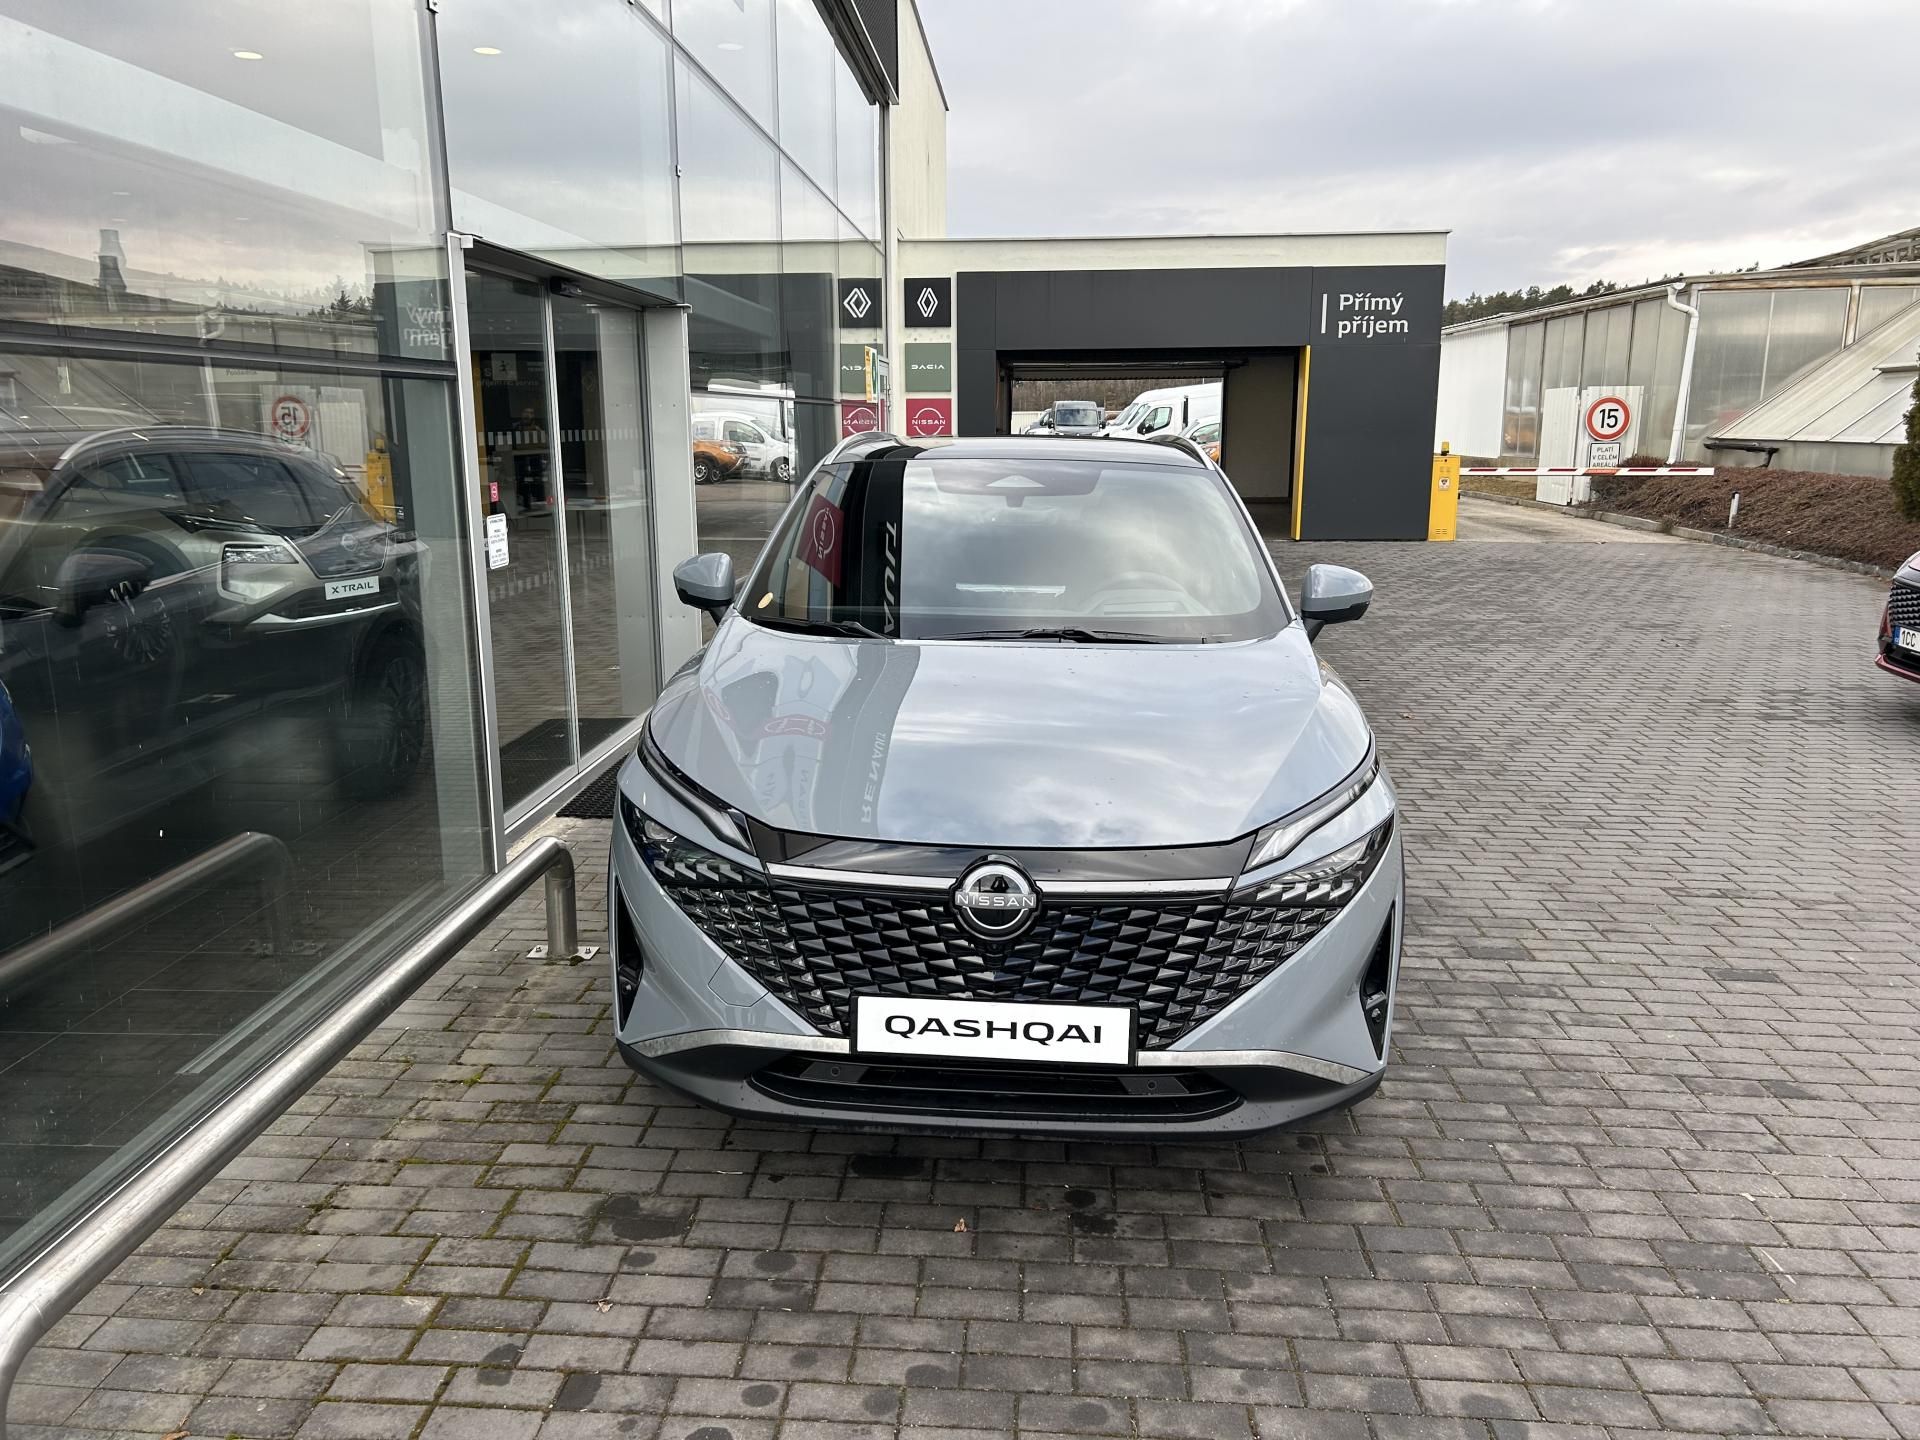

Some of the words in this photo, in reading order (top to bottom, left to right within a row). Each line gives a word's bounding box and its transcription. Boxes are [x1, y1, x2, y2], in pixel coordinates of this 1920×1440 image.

[1339, 292, 1404, 315] Přímý
[1337, 315, 1409, 339] příjem
[1599, 408, 1619, 429] 15
[331, 586, 340, 594] X
[341, 581, 374, 592] TRAIL
[955, 893, 1036, 908] NISSAN
[884, 1014, 1102, 1046] QASHQAI
